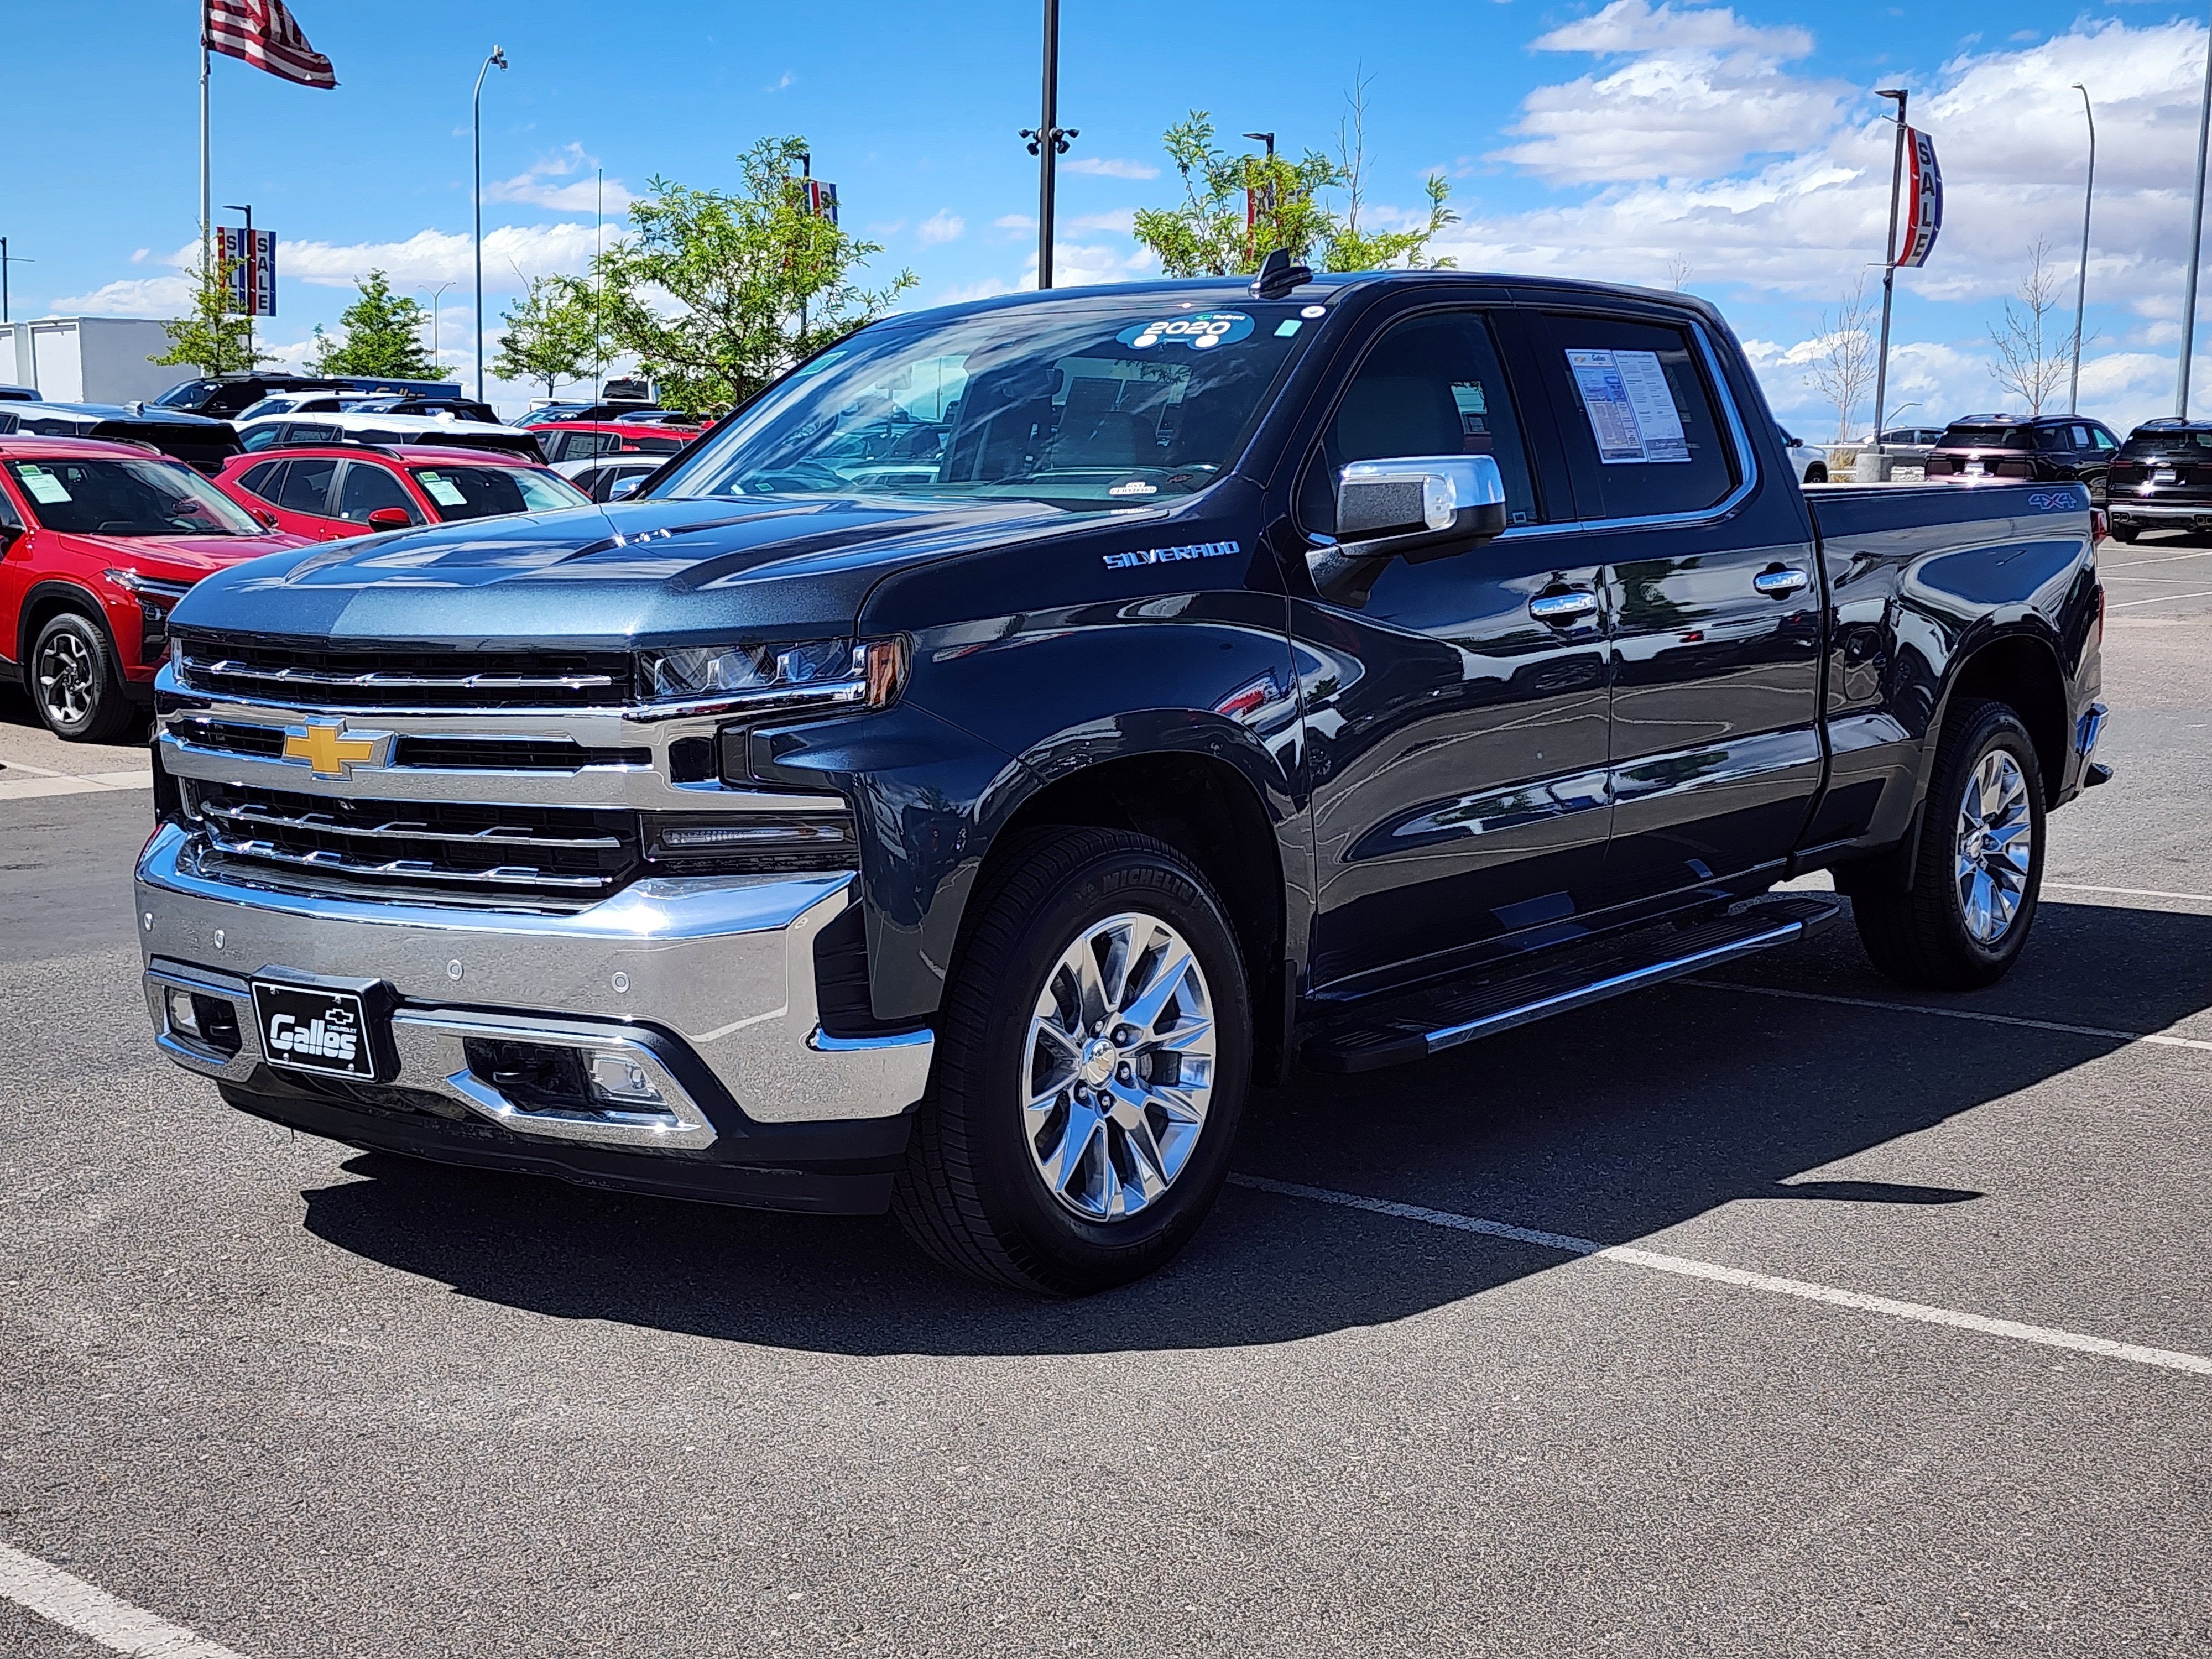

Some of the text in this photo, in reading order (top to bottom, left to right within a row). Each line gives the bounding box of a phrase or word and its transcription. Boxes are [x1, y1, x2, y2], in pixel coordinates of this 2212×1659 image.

[1911, 142, 1936, 258] SALE
[257, 237, 269, 309] SALE
[1142, 321, 1231, 335] 2020
[1103, 540, 1240, 570] SILVERADO
[1103, 868, 1194, 902] MICHELIN
[270, 1013, 357, 1060] Gallos
